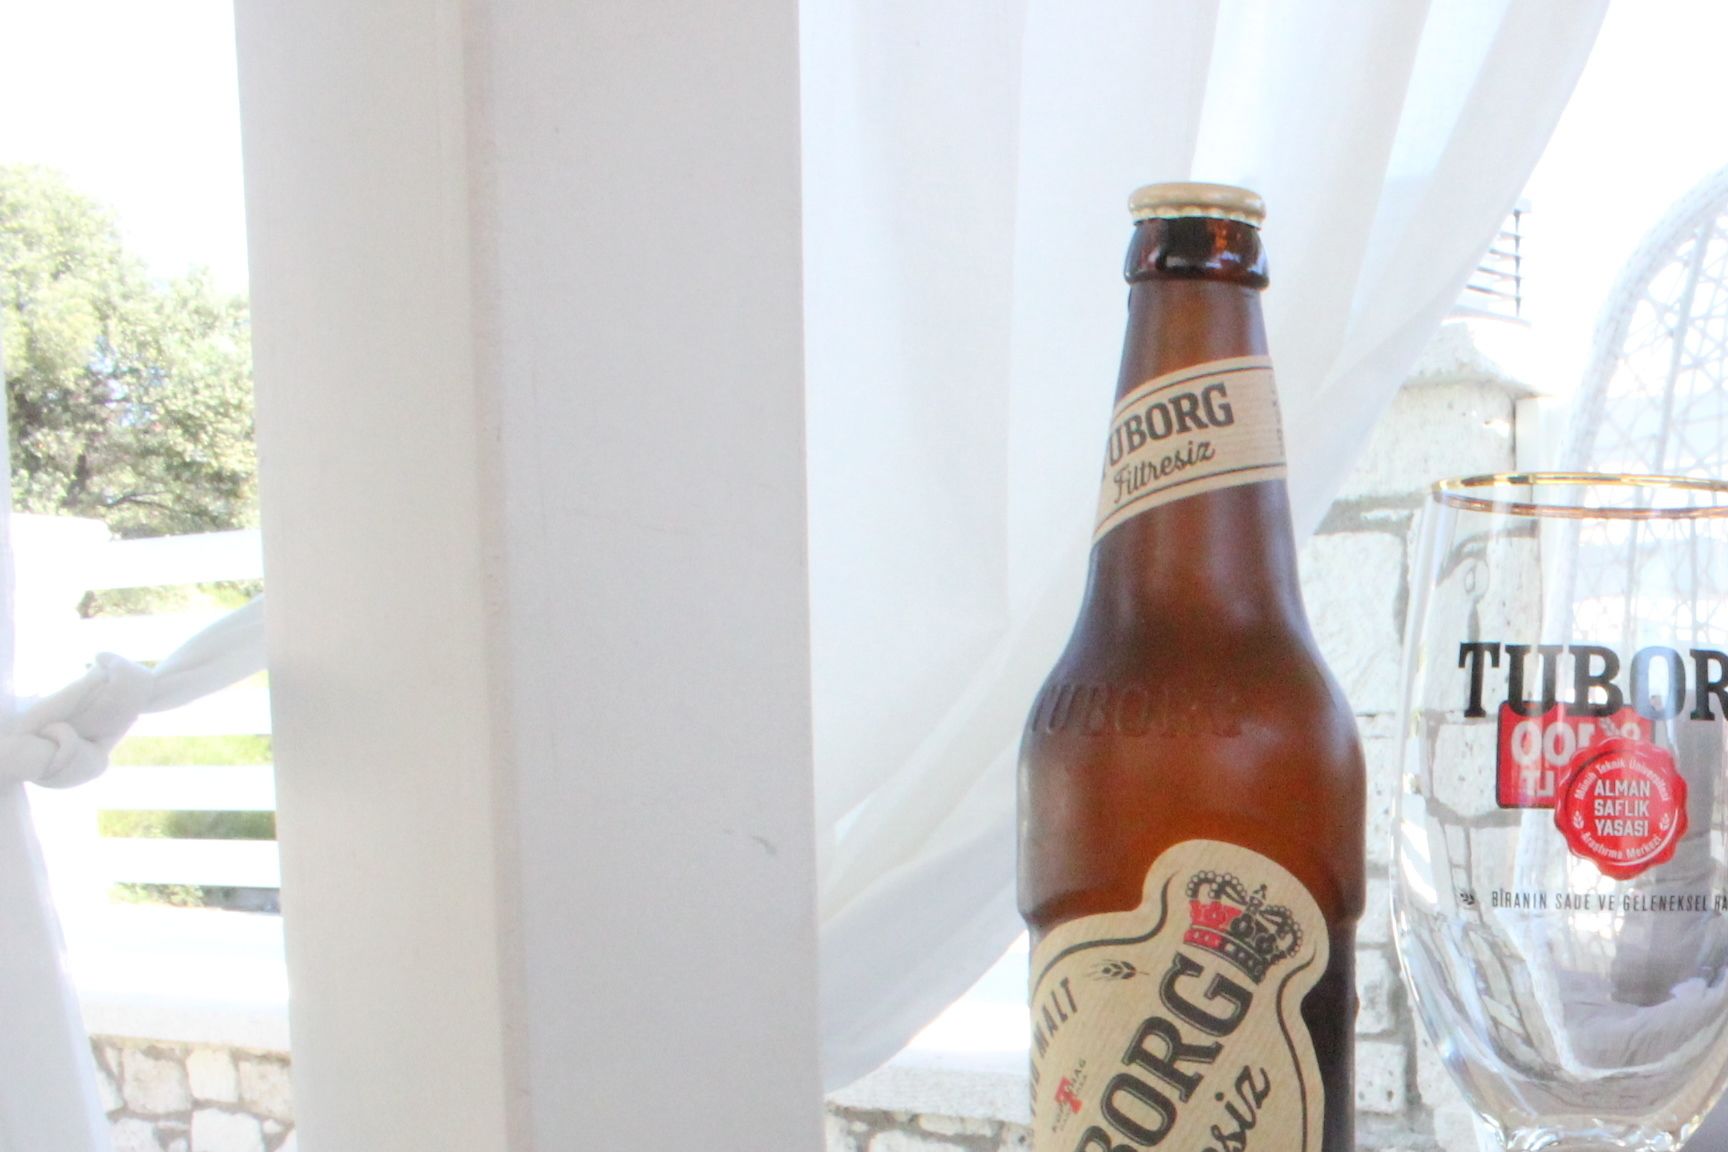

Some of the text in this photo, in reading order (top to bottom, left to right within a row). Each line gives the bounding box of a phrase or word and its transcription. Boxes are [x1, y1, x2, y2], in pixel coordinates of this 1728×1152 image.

[1102, 381, 1234, 482] UBORG
[1114, 440, 1216, 504] Filtresiz
[1594, 779, 1650, 797] ALMAN
[1594, 799, 1650, 817] SAFLIK
[1595, 819, 1649, 837] YASASI
[1555, 893, 1590, 911] SADE
[1599, 893, 1615, 911] VE
[1623, 894, 1707, 912] GELENEKSEL
